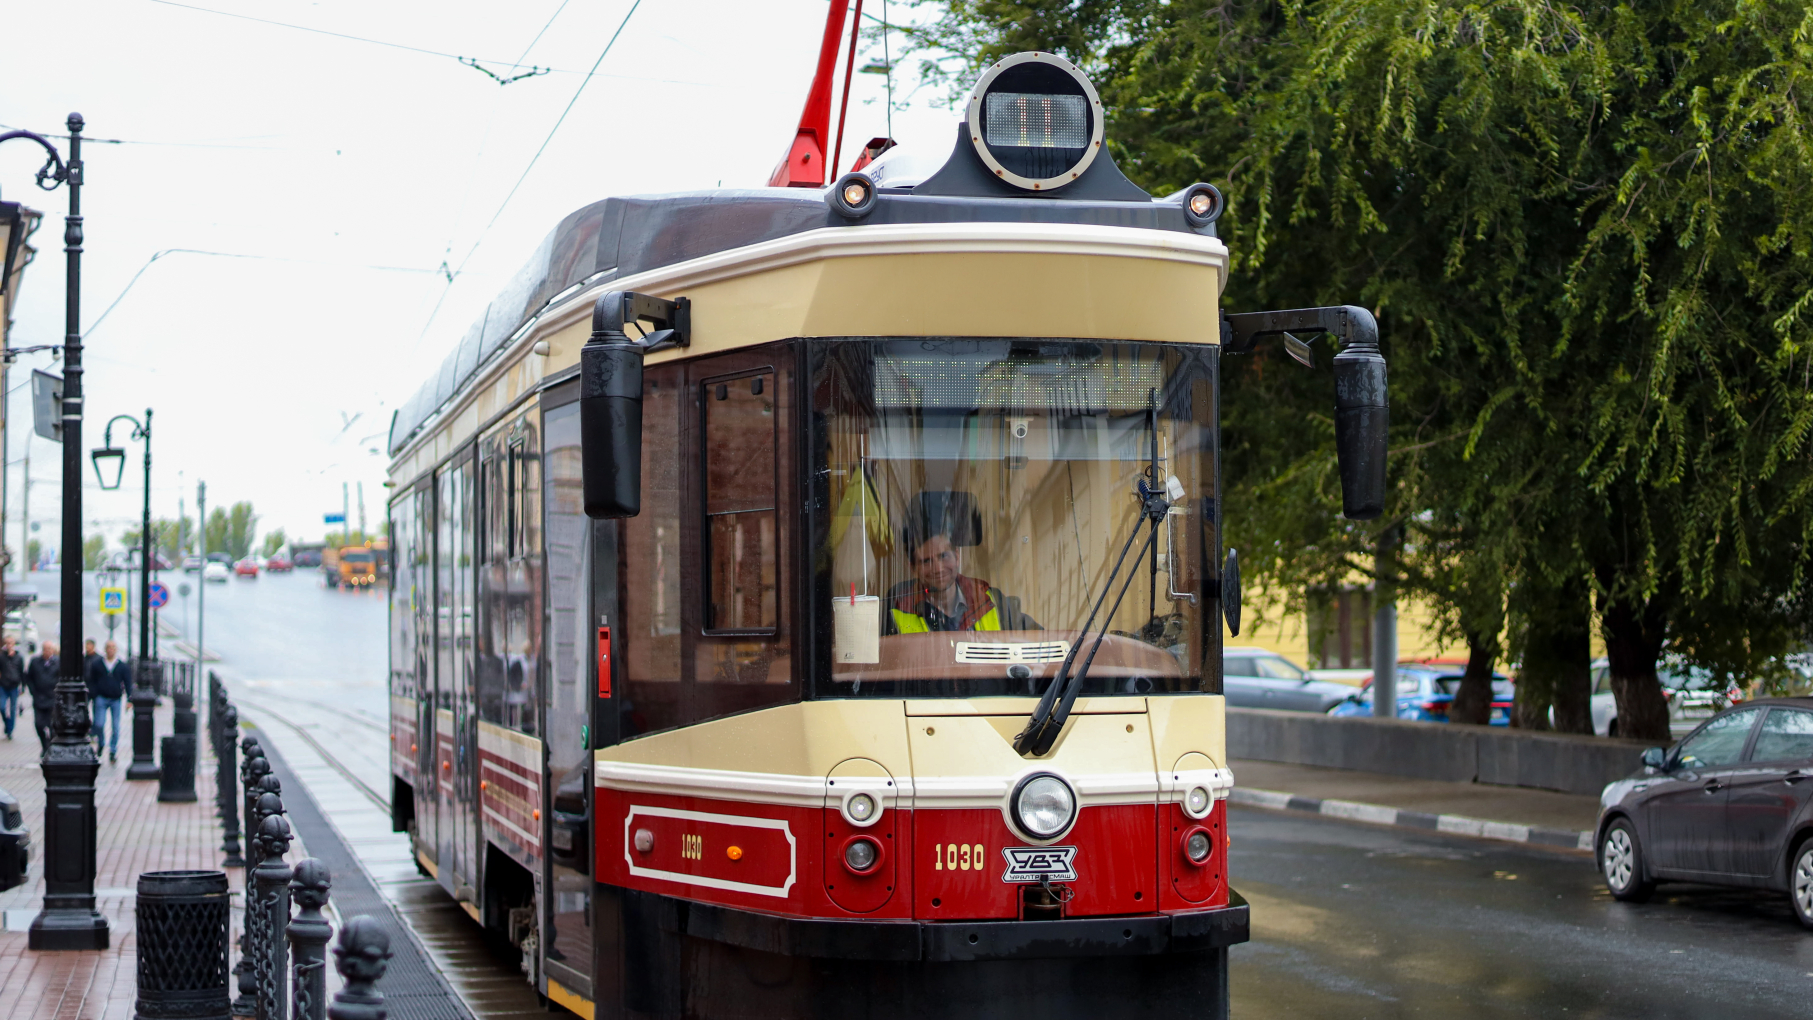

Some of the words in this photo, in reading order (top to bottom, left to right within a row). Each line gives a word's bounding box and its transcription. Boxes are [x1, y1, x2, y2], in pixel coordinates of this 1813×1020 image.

[1017, 97, 1054, 147] 11
[682, 833, 702, 860] 1030
[935, 843, 984, 870] 1030
